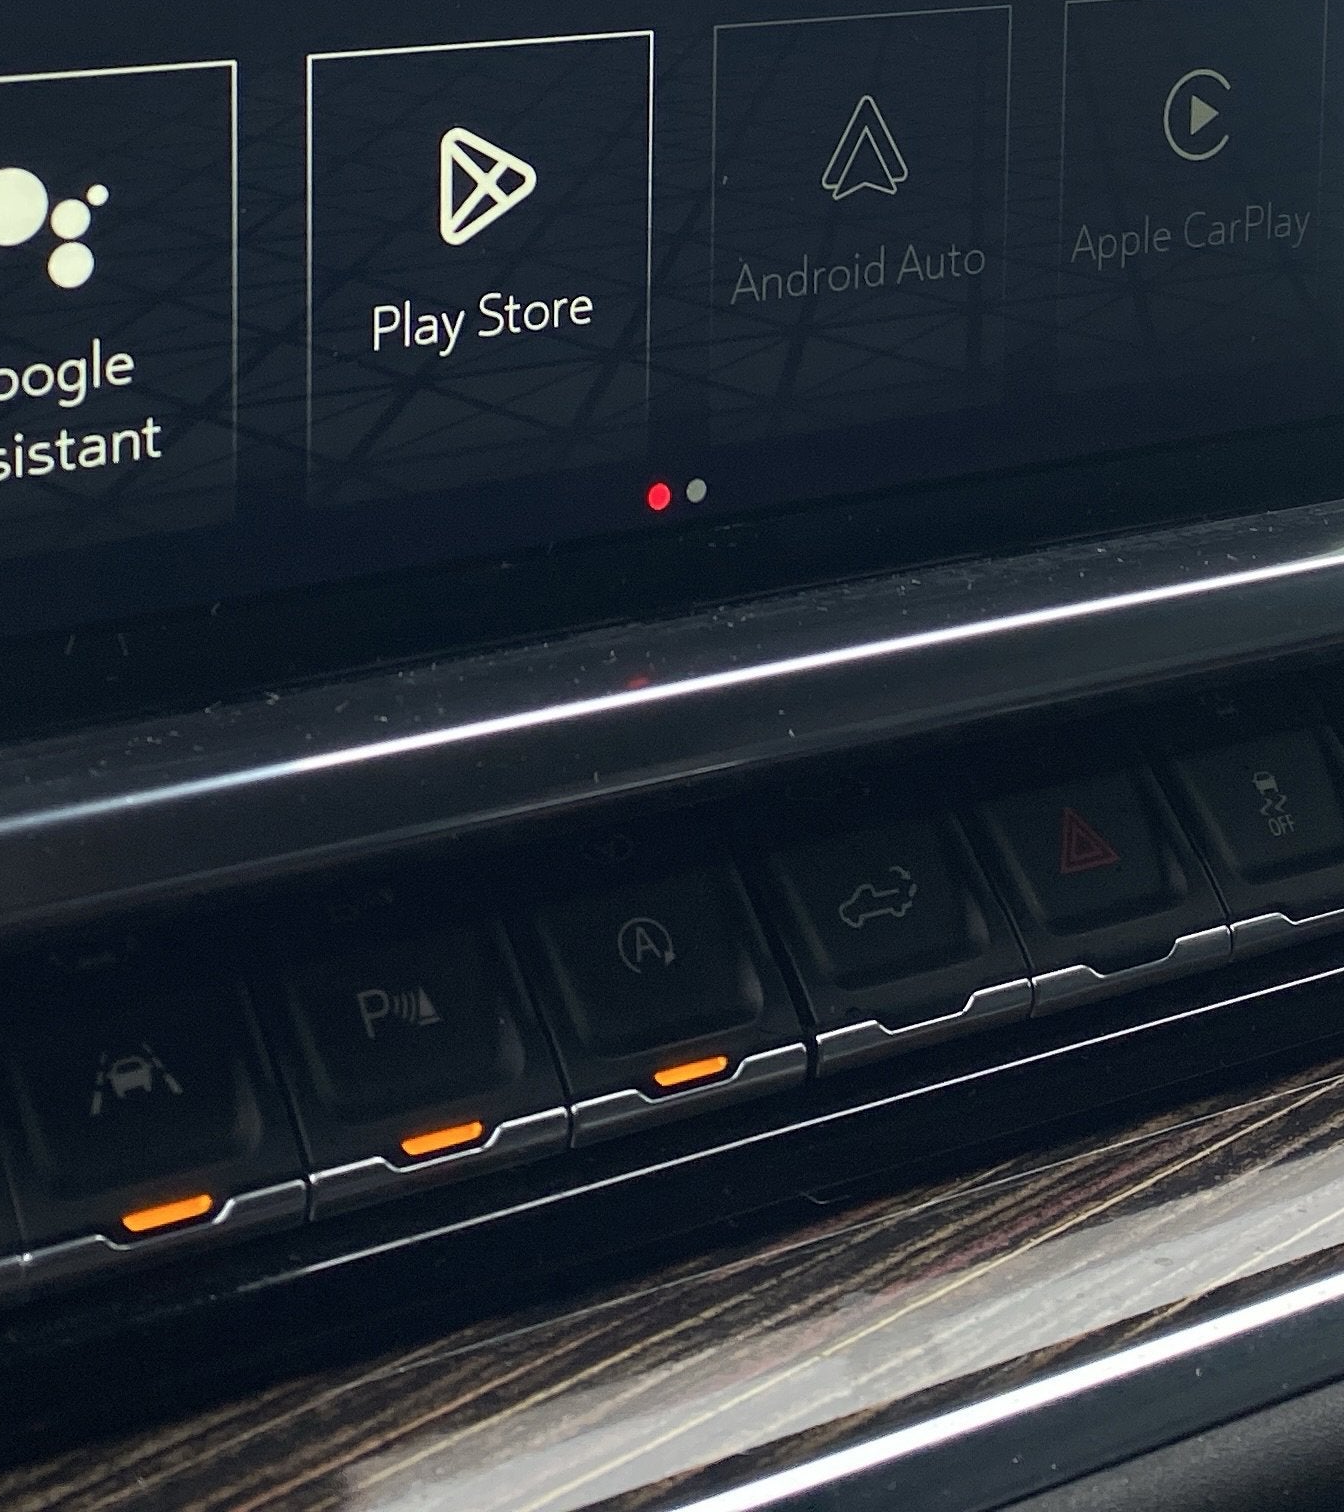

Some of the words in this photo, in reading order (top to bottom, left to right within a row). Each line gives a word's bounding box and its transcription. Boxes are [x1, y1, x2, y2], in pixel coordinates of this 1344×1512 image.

[1070, 215, 1172, 271] Apple
[1183, 201, 1312, 249] CarPlay
[730, 244, 887, 306] Android
[896, 243, 987, 285] Auto
[372, 299, 466, 357] Play
[477, 292, 594, 339] Store
[1267, 814, 1296, 836] OFF
